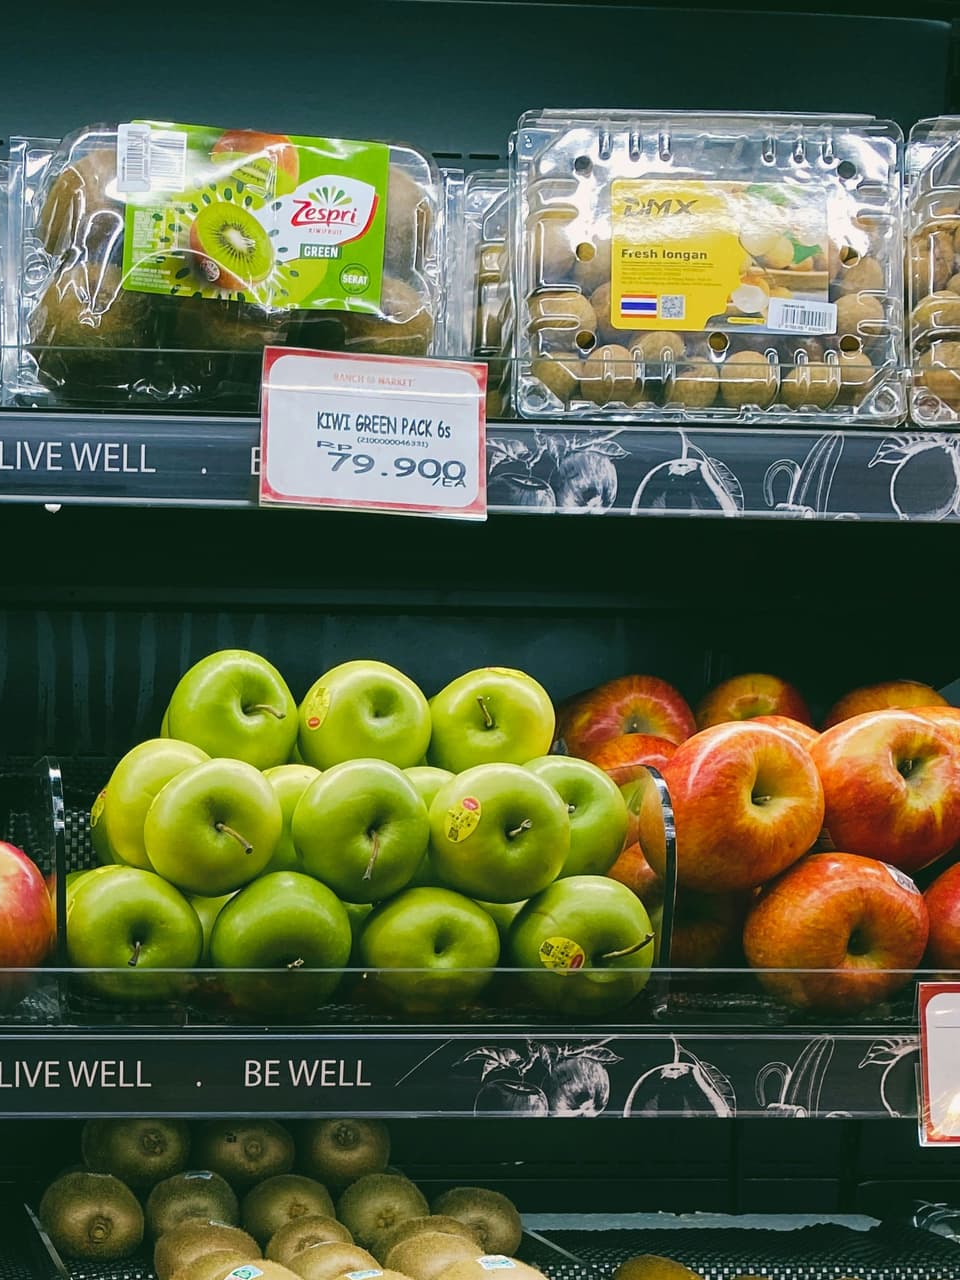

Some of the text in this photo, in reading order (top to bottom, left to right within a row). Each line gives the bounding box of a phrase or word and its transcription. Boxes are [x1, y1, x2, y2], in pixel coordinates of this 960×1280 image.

[290, 199, 359, 227] Zespri
[304, 246, 338, 258] GREEN
[621, 249, 707, 261] Fresh longan
[333, 372, 413, 387] RANCH MARKET
[317, 411, 351, 432] KIWI
[355, 414, 397, 435] GREEN
[402, 417, 432, 437] PACK
[71, 442, 156, 473] WELL
[316, 440, 352, 451] Rp
[327, 451, 467, 481] 79.900
[68, 1060, 152, 1088] WELL
[244, 1060, 280, 1087] BE
[288, 1059, 372, 1087] WELL
